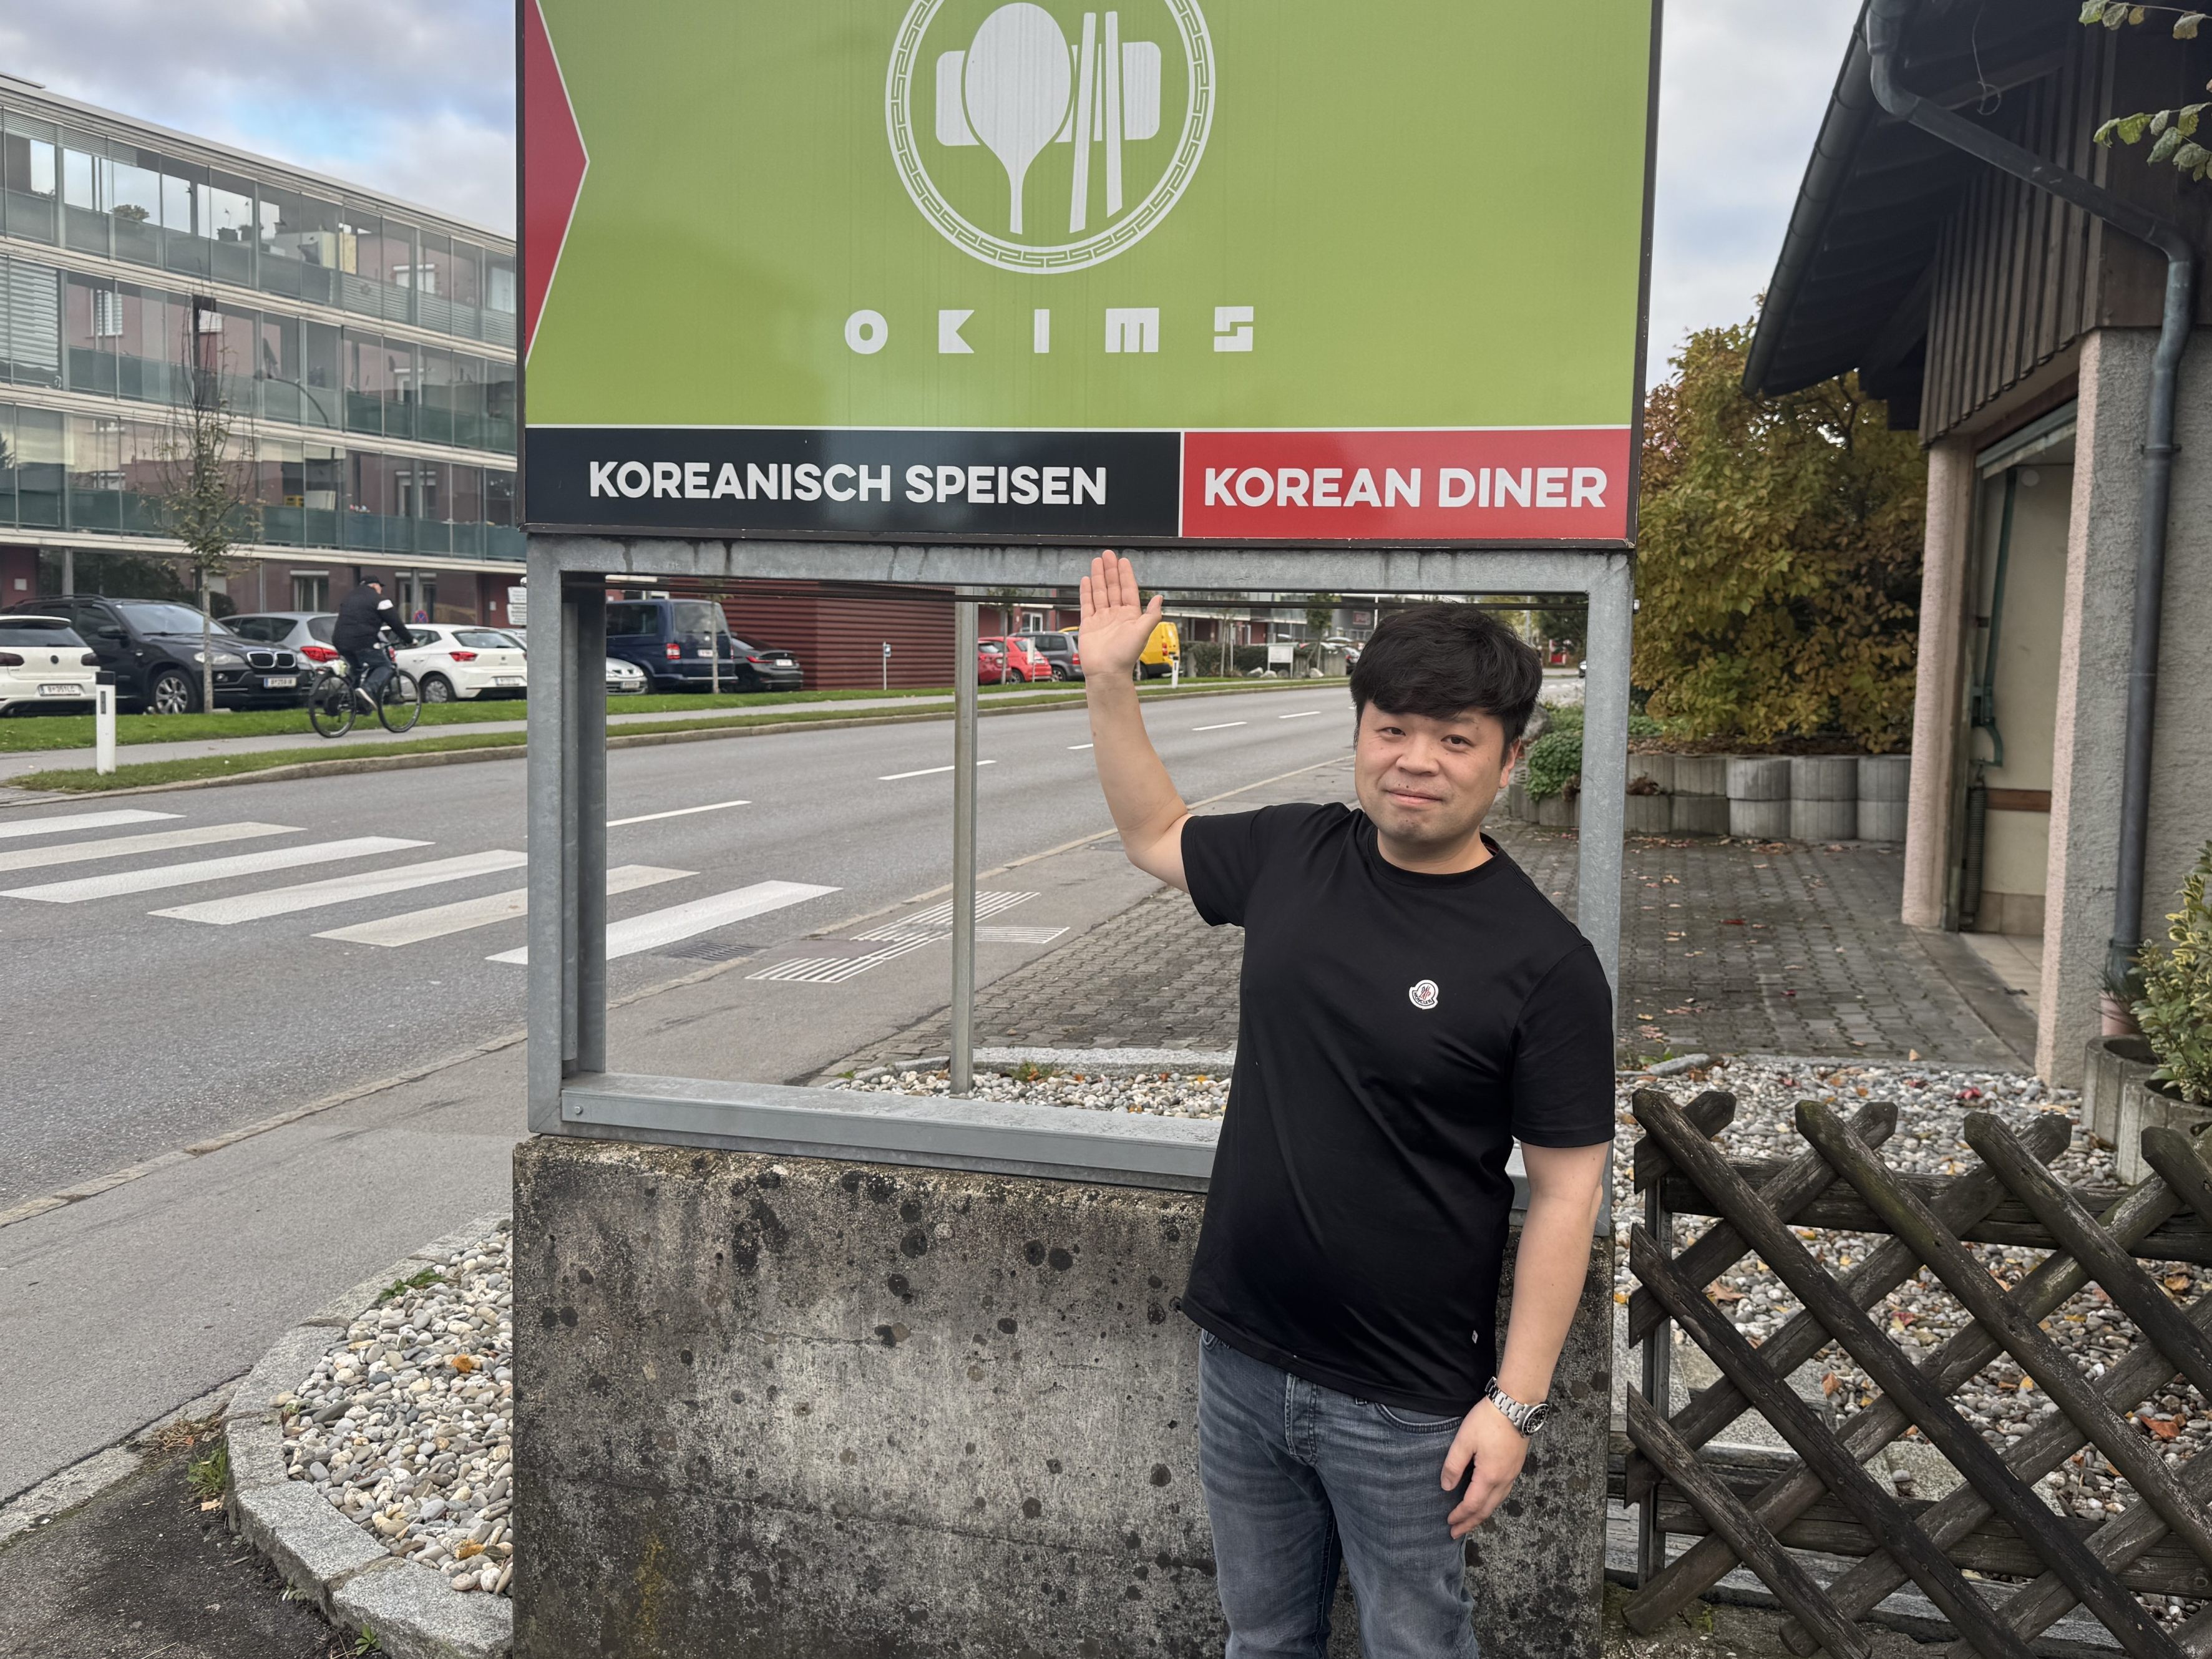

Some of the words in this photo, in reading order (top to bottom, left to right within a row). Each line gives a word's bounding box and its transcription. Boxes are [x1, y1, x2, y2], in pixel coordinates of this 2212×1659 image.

[844, 306, 1254, 354] OKIMS
[589, 460, 892, 502] KOREANISCH
[905, 464, 1107, 505] SPEISEN
[1204, 467, 1421, 508] KOREAN
[1438, 467, 1608, 508] DINER
[1413, 991, 1433, 1005] MONCLER
